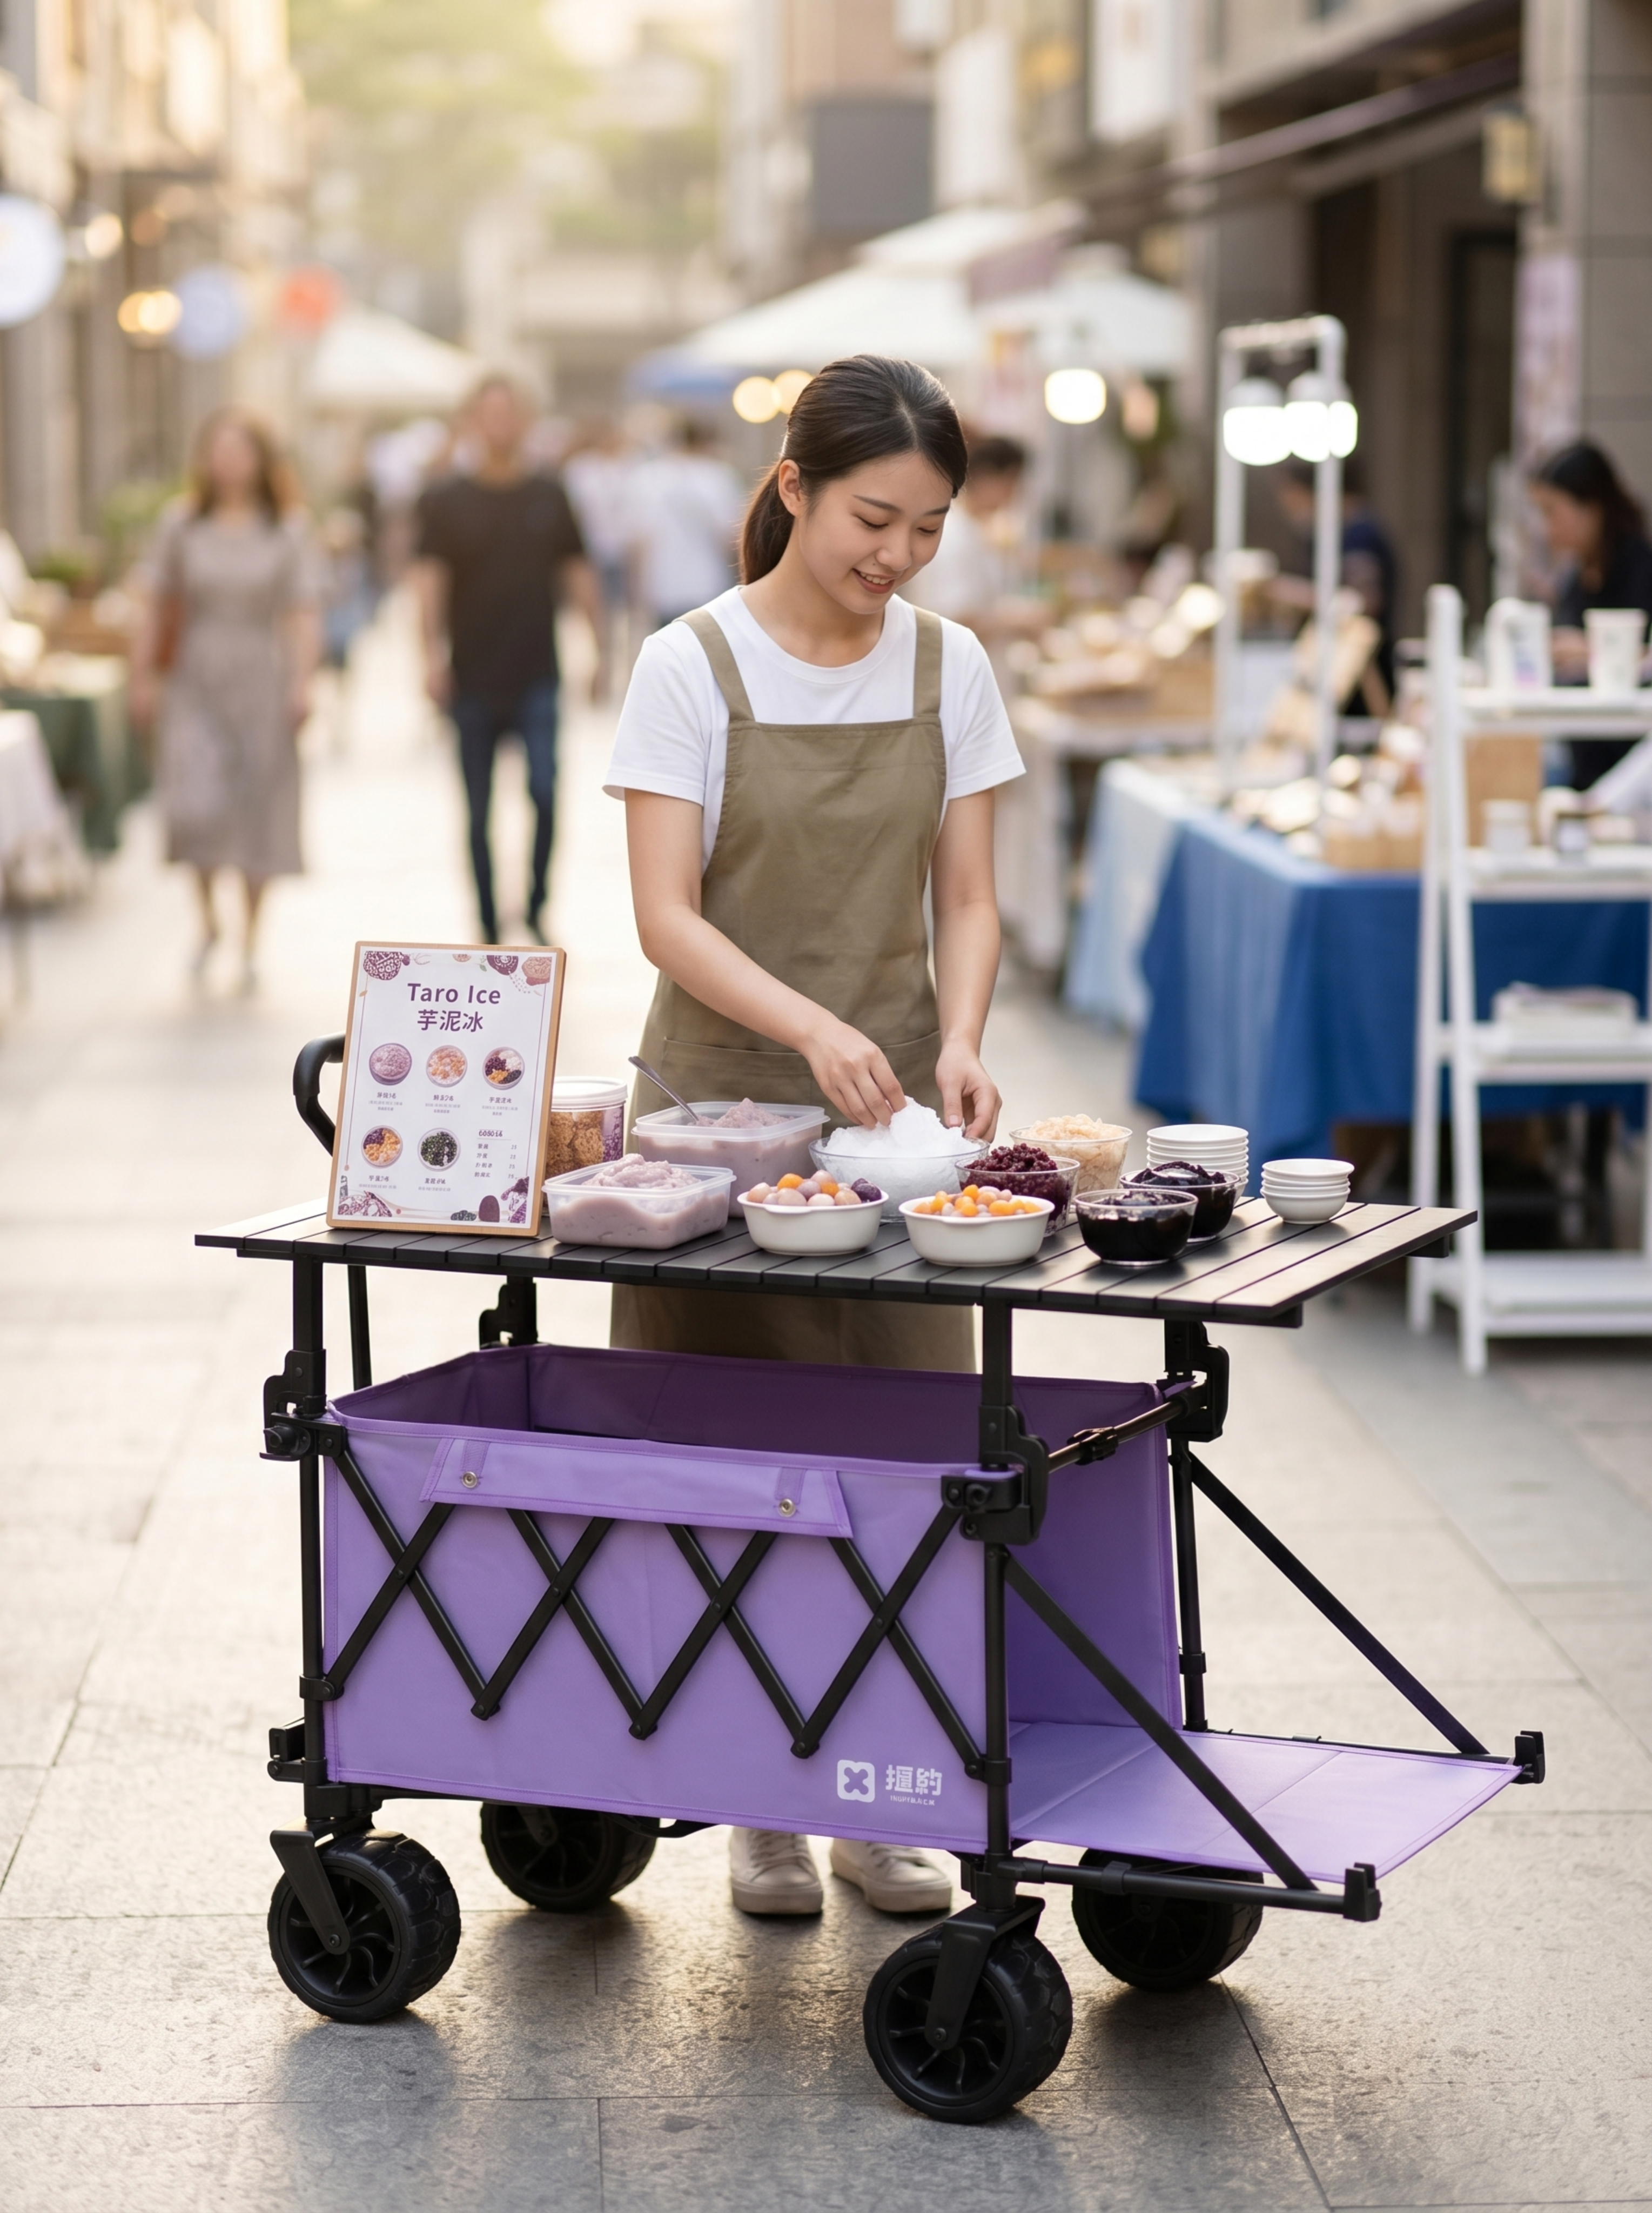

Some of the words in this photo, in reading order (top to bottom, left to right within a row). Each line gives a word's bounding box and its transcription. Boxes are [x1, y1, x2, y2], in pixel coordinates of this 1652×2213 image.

[407, 983, 459, 1003] Taro
[468, 985, 501, 1004] Ice
[417, 1009, 483, 1032] 芋泥冰
